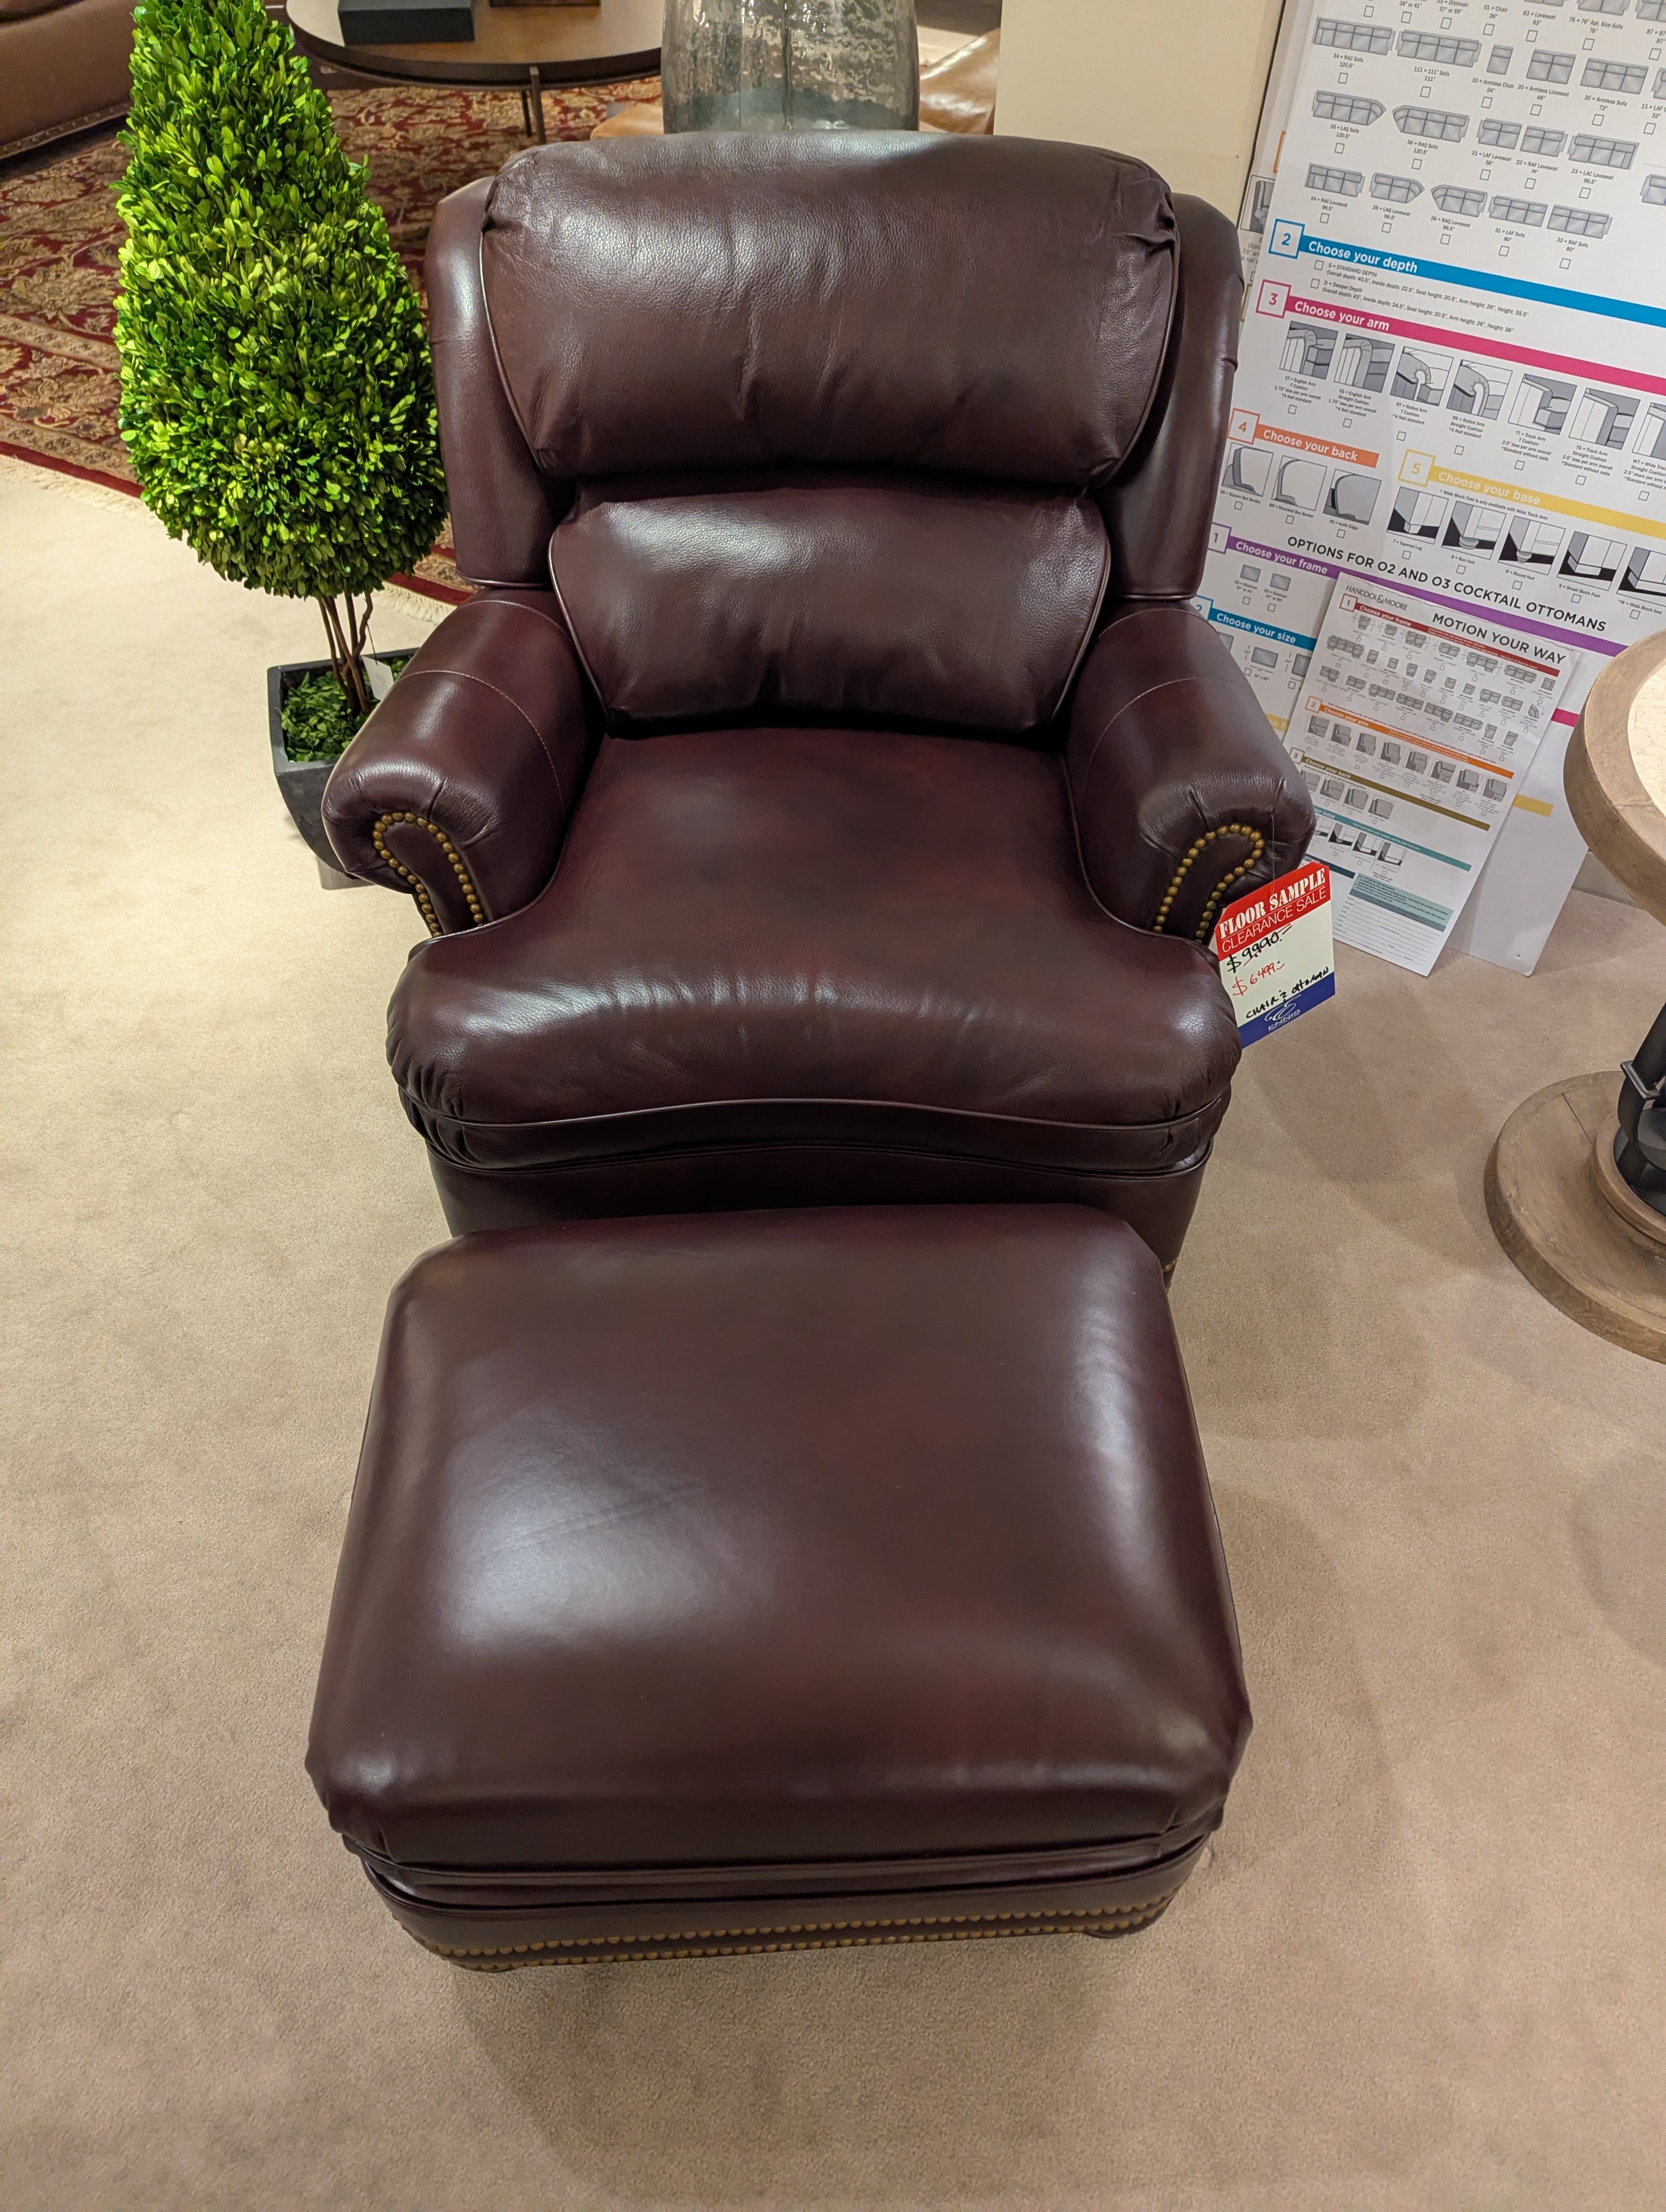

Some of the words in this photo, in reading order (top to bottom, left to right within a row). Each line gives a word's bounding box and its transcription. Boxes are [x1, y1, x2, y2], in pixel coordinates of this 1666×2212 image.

[1281, 233, 1291, 246] 2
[1309, 241, 1350, 258] Choose
[1354, 253, 1380, 264] your
[1383, 257, 1417, 272] depth
[1336, 265, 1361, 273] STANDARD
[1268, 293, 1278, 305] 3
[1295, 301, 1335, 318] Choose
[1338, 313, 1364, 324] your
[1367, 319, 1389, 331] arm
[1238, 422, 1246, 432] 4
[1264, 430, 1302, 446] Choose
[1305, 442, 1329, 453] your
[1331, 446, 1357, 460] back
[1411, 462, 1421, 474] 5
[1439, 472, 1480, 490] Choose
[1484, 485, 1509, 496] your
[1513, 490, 1540, 504] base
[1214, 533, 1218, 543] 1
[1236, 542, 1271, 558] Choose
[1274, 554, 1296, 564] your
[1299, 559, 1327, 574] frame
[1288, 537, 1343, 559] OPTIONS
[1347, 552, 1374, 568] FOR
[1398, 567, 1427, 582] AND
[1454, 582, 1520, 609] COCKTAIL
[1526, 602, 1606, 631] OTTOMANS
[1346, 585, 1407, 610] HANCOCK&MOORE
[1196, 605, 1202, 613] 2
[1216, 613, 1251, 629] Choose
[1254, 626, 1274, 638] your
[1277, 632, 1296, 643] size
[1360, 606, 1380, 616] Choose
[1395, 617, 1411, 626] frame
[1432, 613, 1487, 639] MOTION
[1492, 632, 1529, 653] YOUR
[1534, 646, 1566, 664] WAY
[1324, 708, 1344, 717] Choose
[1305, 759, 1324, 769] Choose
[1219, 902, 1266, 939] FLOOR
[1270, 868, 1325, 909] SAMPLE
[1222, 909, 1293, 953] CLEARANCE
[1297, 886, 1326, 912] SALE
[1246, 996, 1279, 1018] CHAIR
[1268, 1009, 1300, 1031] ENNIS
